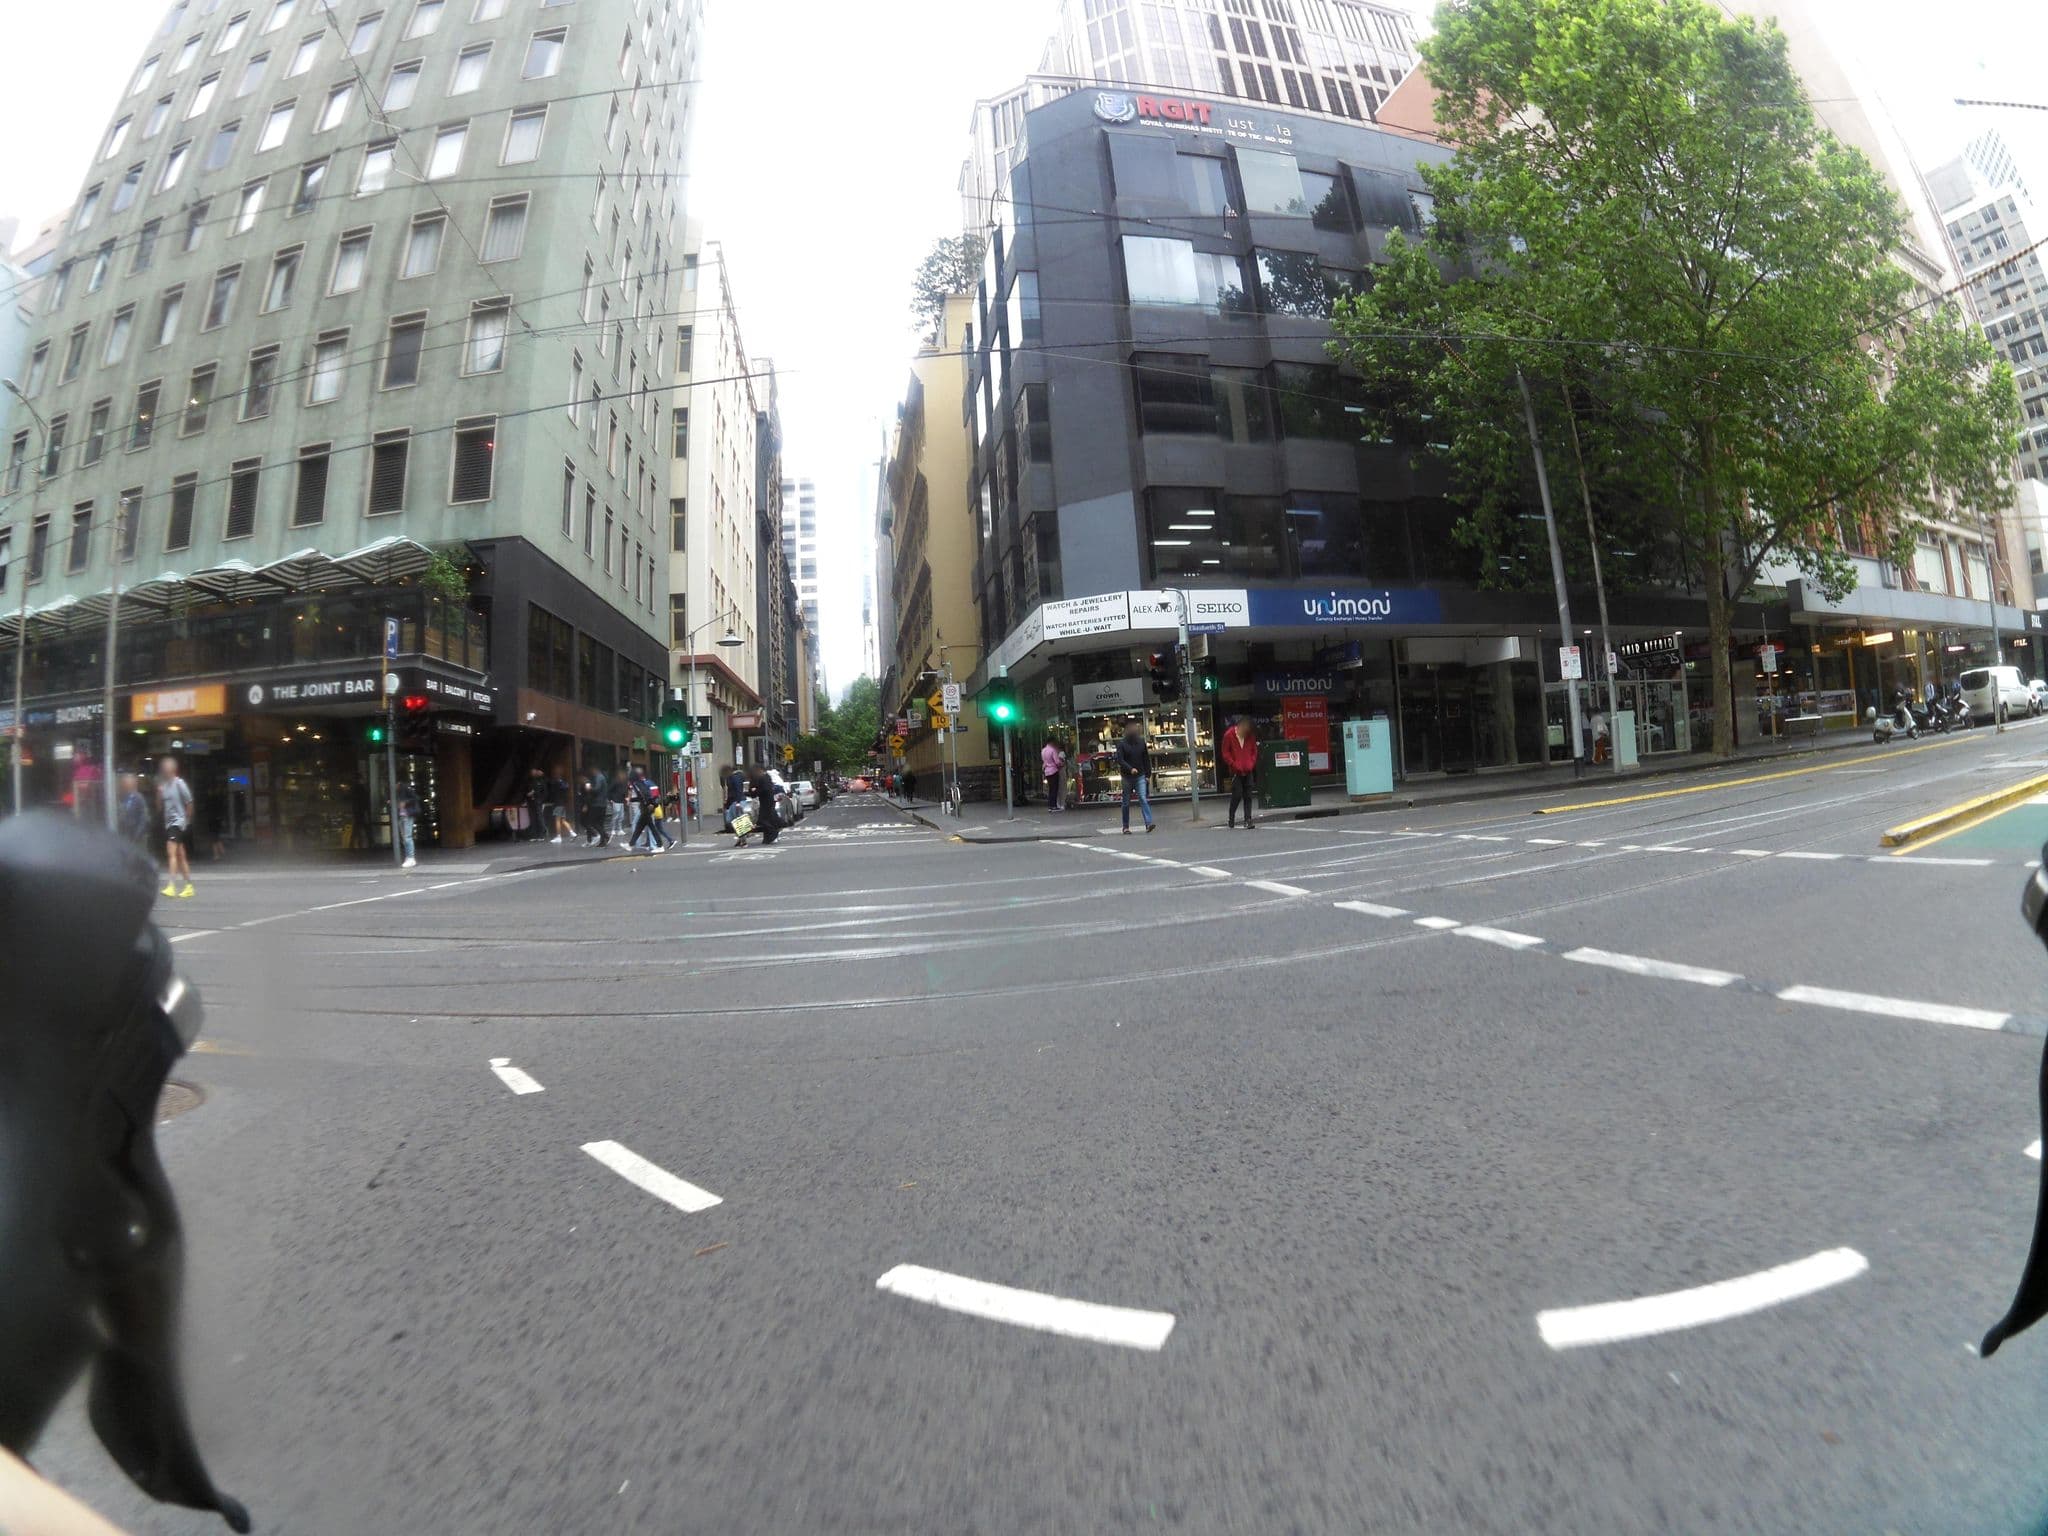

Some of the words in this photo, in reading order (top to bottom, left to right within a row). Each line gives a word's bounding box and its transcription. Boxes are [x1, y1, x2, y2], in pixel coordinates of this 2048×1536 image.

[1137, 95, 1213, 125] RGIT
[1140, 119, 1163, 128] ROYAL
[1047, 602, 1071, 611] WATCH
[1080, 594, 1122, 606] JEWELLERY
[1196, 602, 1242, 614] SEIKO
[1304, 591, 1391, 616] unimoni
[1069, 604, 1100, 615] REPAIRS
[1133, 605, 1152, 614] ALEX
[1046, 621, 1067, 630] WATCH
[1068, 618, 1102, 628] BATTERIES
[1103, 614, 1126, 622] FITTED
[1217, 623, 1224, 632] St
[387, 620, 396, 641] P
[1059, 627, 1081, 636] WHILE
[1094, 623, 1112, 632] WAIT
[272, 685, 298, 700] THE
[300, 682, 341, 697] JOINT
[345, 679, 375, 694] BAR
[426, 679, 439, 691] BAR
[1096, 692, 1120, 700] crown
[1287, 711, 1301, 719] For
[1301, 711, 1324, 719] Lease
